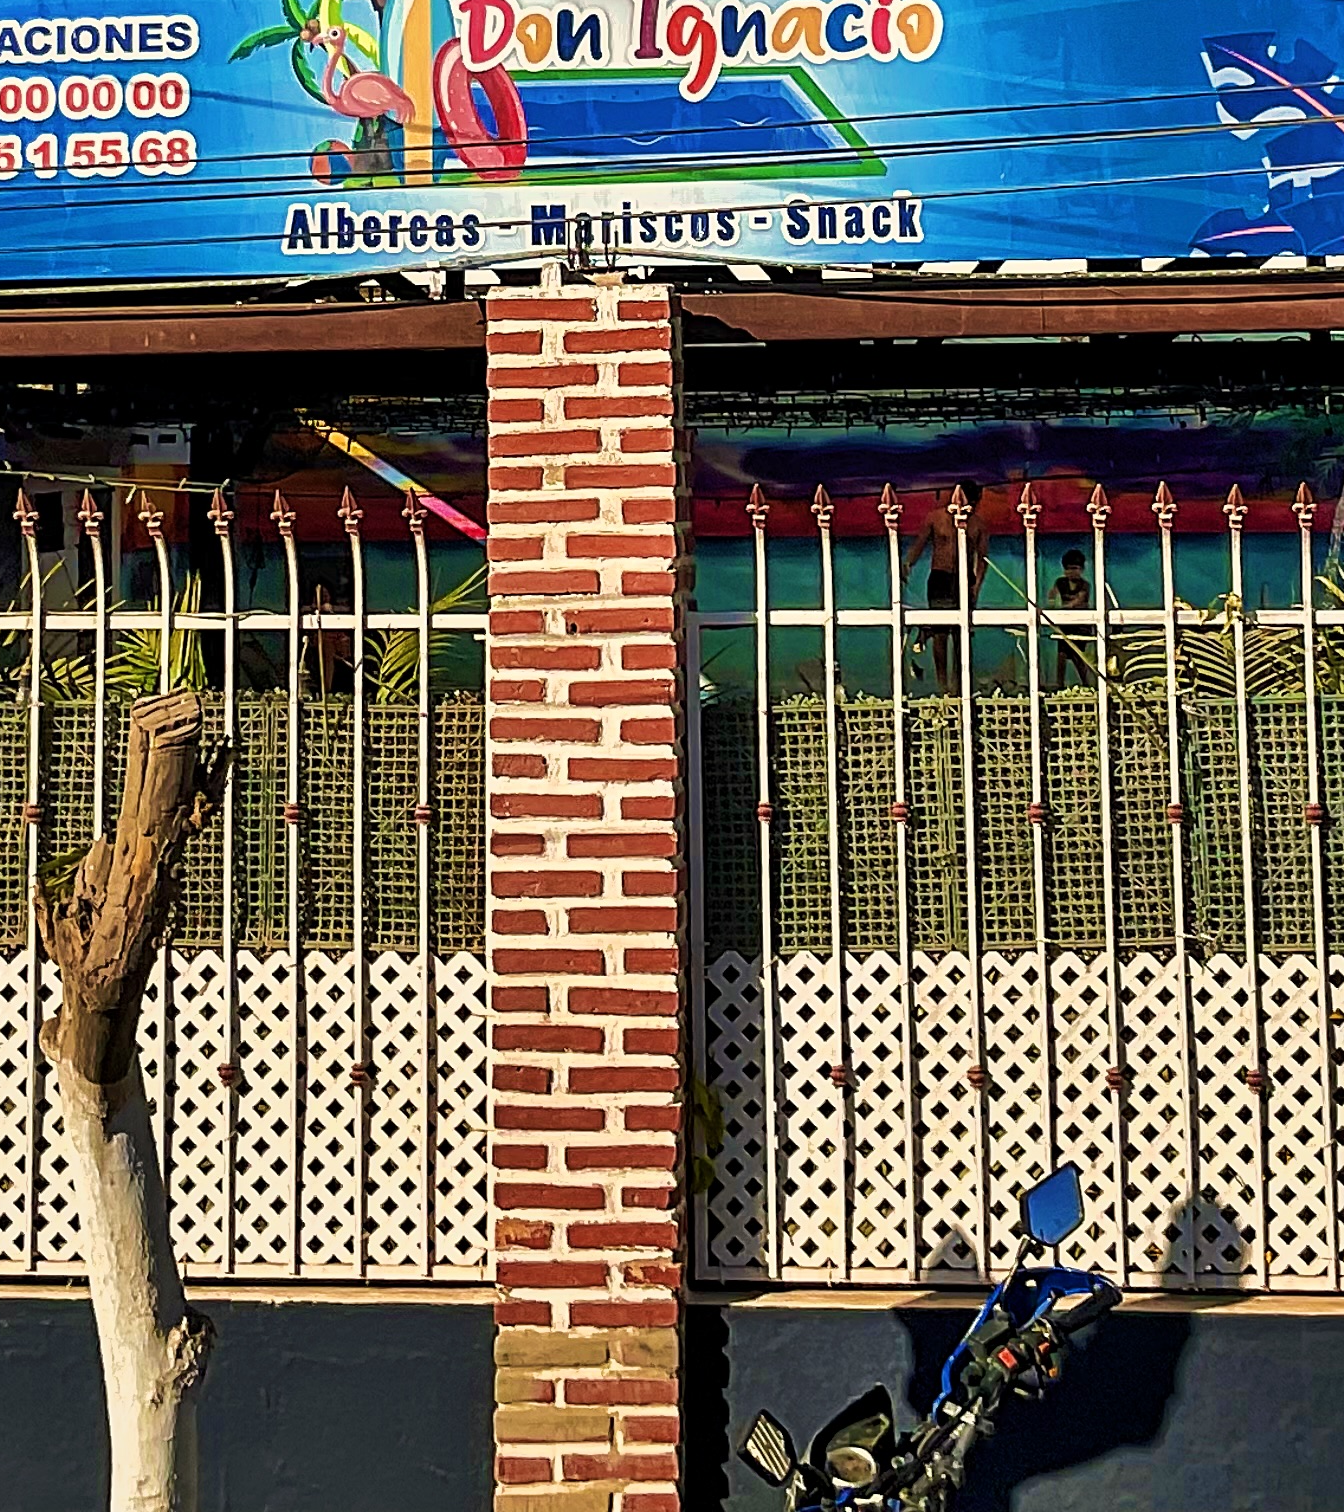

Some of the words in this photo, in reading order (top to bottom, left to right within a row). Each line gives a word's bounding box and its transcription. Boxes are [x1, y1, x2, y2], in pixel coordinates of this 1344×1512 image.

[65, 81, 116, 113] 00
[132, 79, 184, 111] 00
[72, 139, 124, 169] 55
[138, 137, 190, 168] 68
[287, 206, 481, 249] Albercas
[530, 201, 736, 246] Mariscos
[787, 197, 918, 239] Snack
